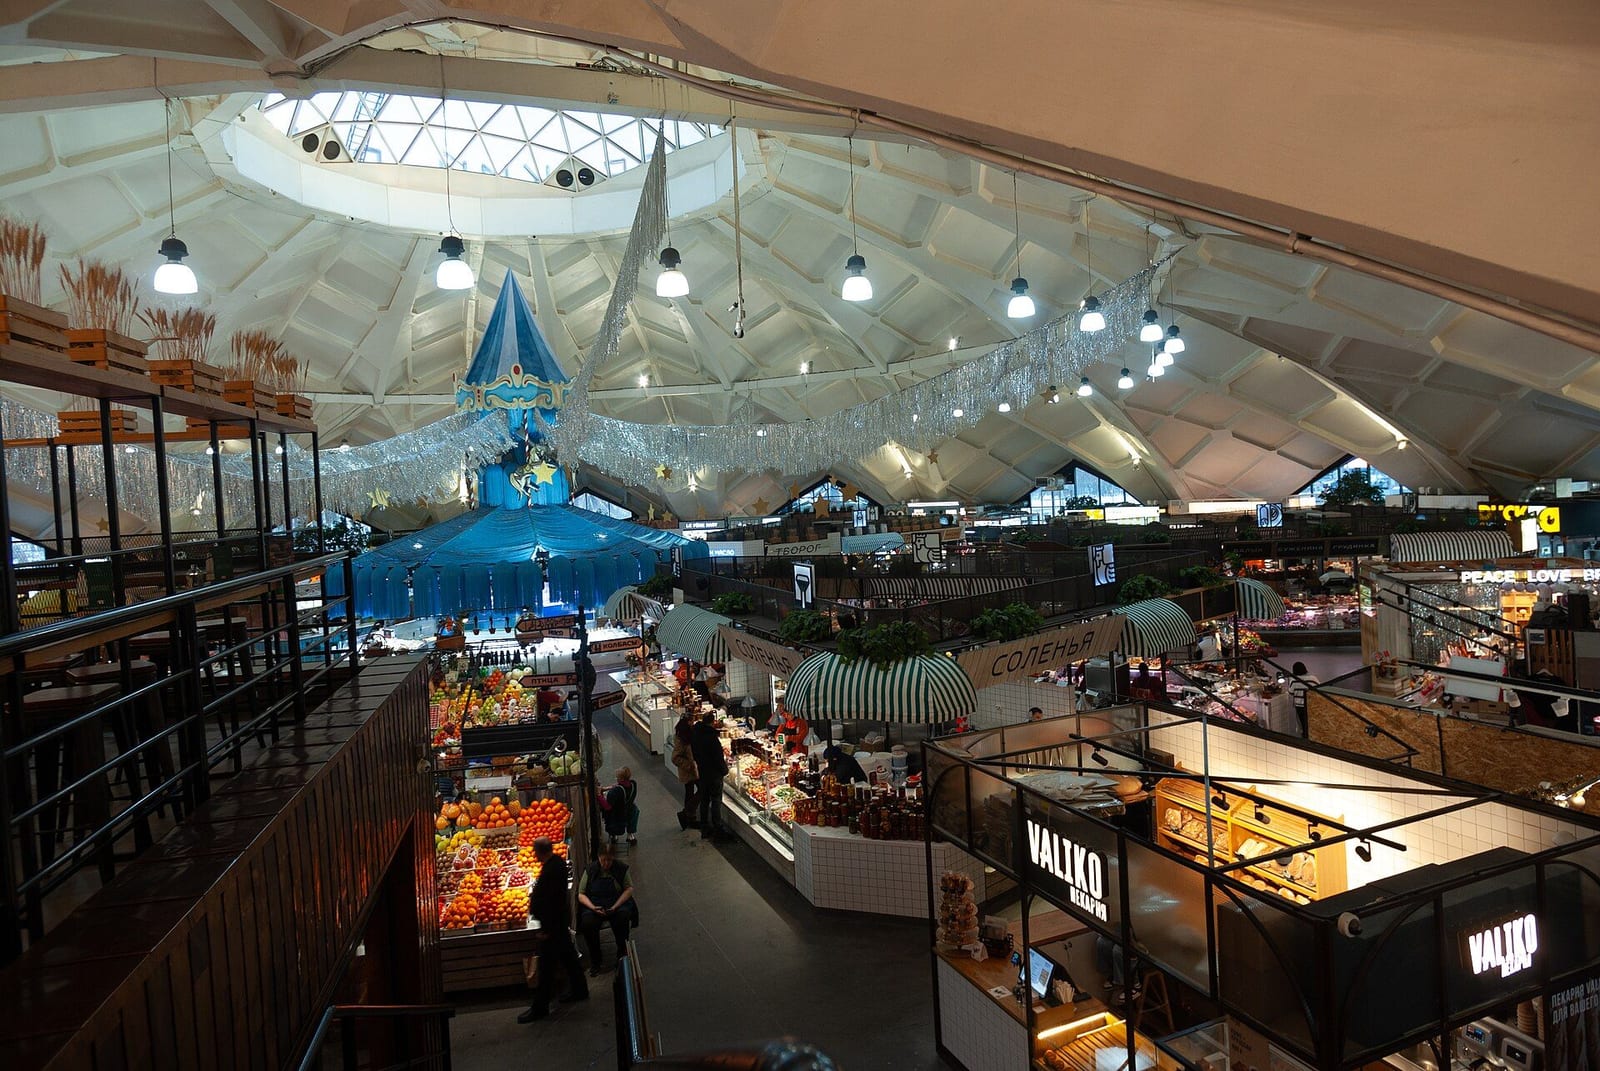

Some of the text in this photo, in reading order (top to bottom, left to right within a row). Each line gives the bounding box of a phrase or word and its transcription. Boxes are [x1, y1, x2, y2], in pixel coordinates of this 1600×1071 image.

[776, 543, 822, 555] ТВОРОГ
[1461, 571, 1516, 583] PEACE
[1527, 569, 1571, 582] LOVE
[602, 640, 638, 650] КОЛБАСЫ
[991, 631, 1095, 677] СОЛЕНЬЯ
[531, 677, 559, 685] ПТИЦА
[1027, 819, 1103, 900] VALIKO
[1069, 885, 1108, 923] ПЕКАРНЯ
[1468, 913, 1538, 975] VALIKO
[1551, 983, 1585, 1009] ПЕКАРНЯ
[1552, 994, 1599, 1025] ДЛЯ ВАШЕГО
